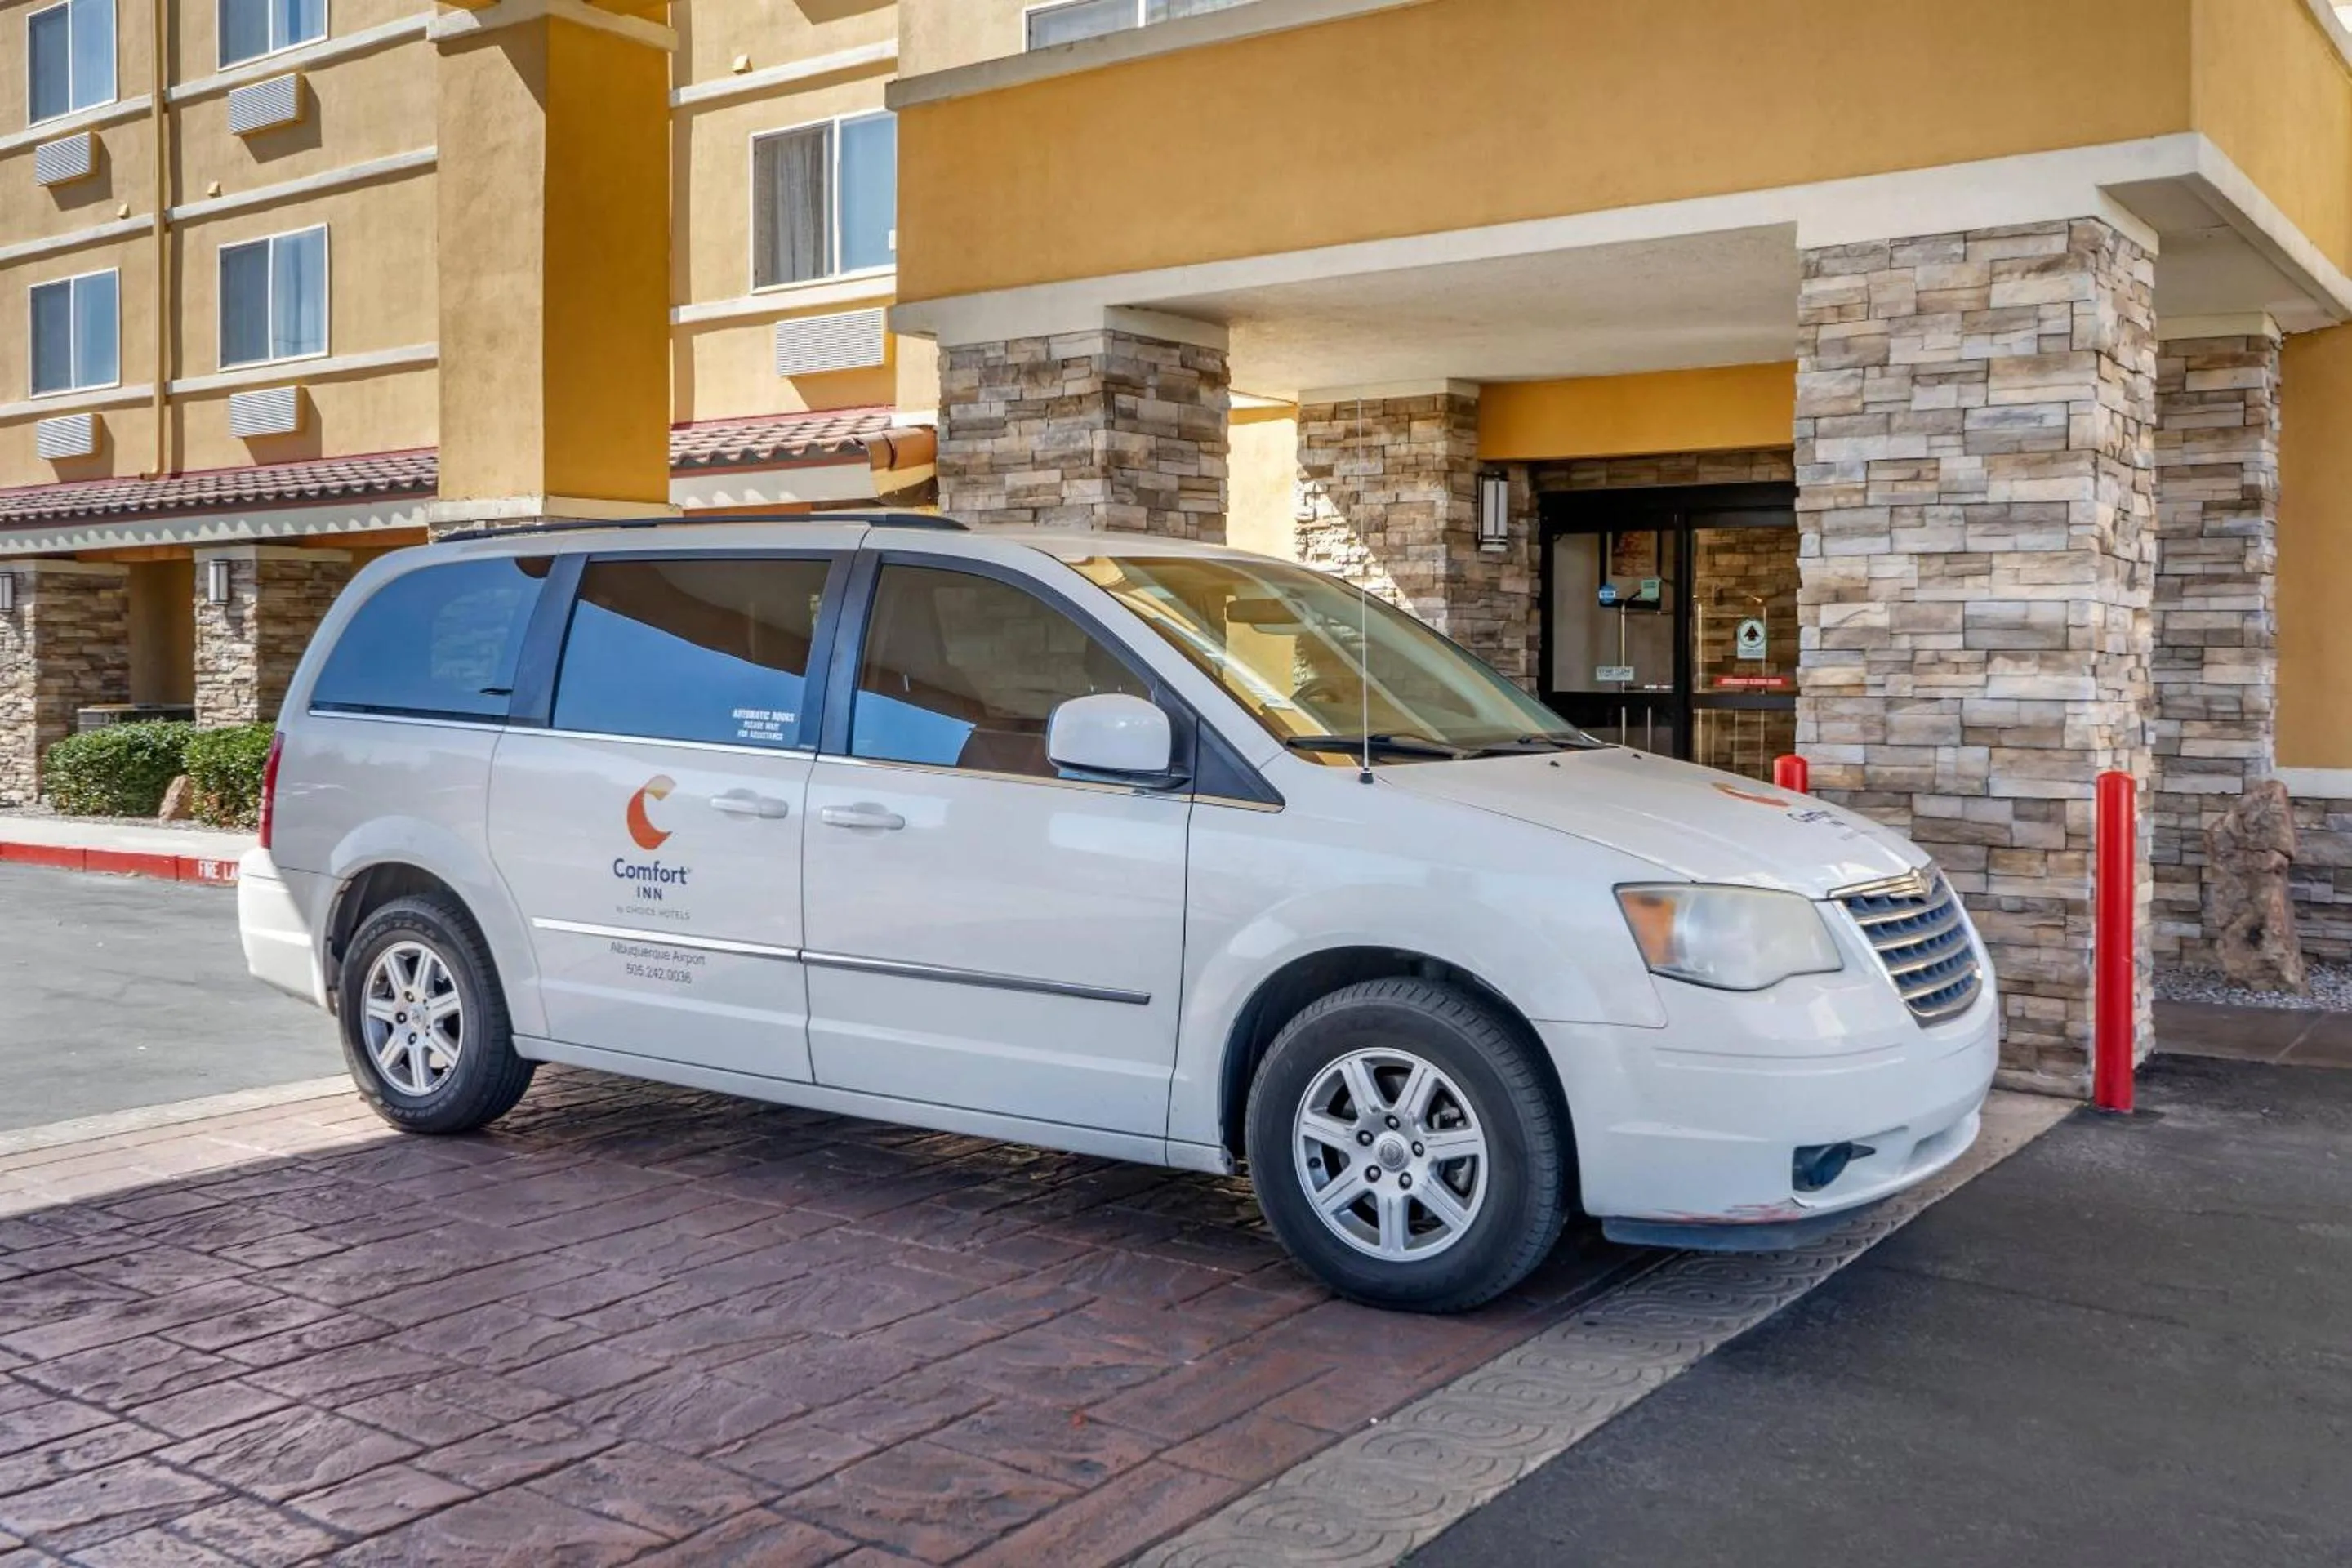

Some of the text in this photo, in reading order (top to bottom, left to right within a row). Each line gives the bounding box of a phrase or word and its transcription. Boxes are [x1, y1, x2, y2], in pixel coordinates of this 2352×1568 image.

[198, 860, 240, 881] FIRE LA
[612, 858, 688, 885] Comfort
[637, 885, 663, 901] INN
[626, 905, 656, 916] CHOICE
[659, 909, 691, 920] HOTELS
[609, 940, 706, 965] Albuquerque Airport
